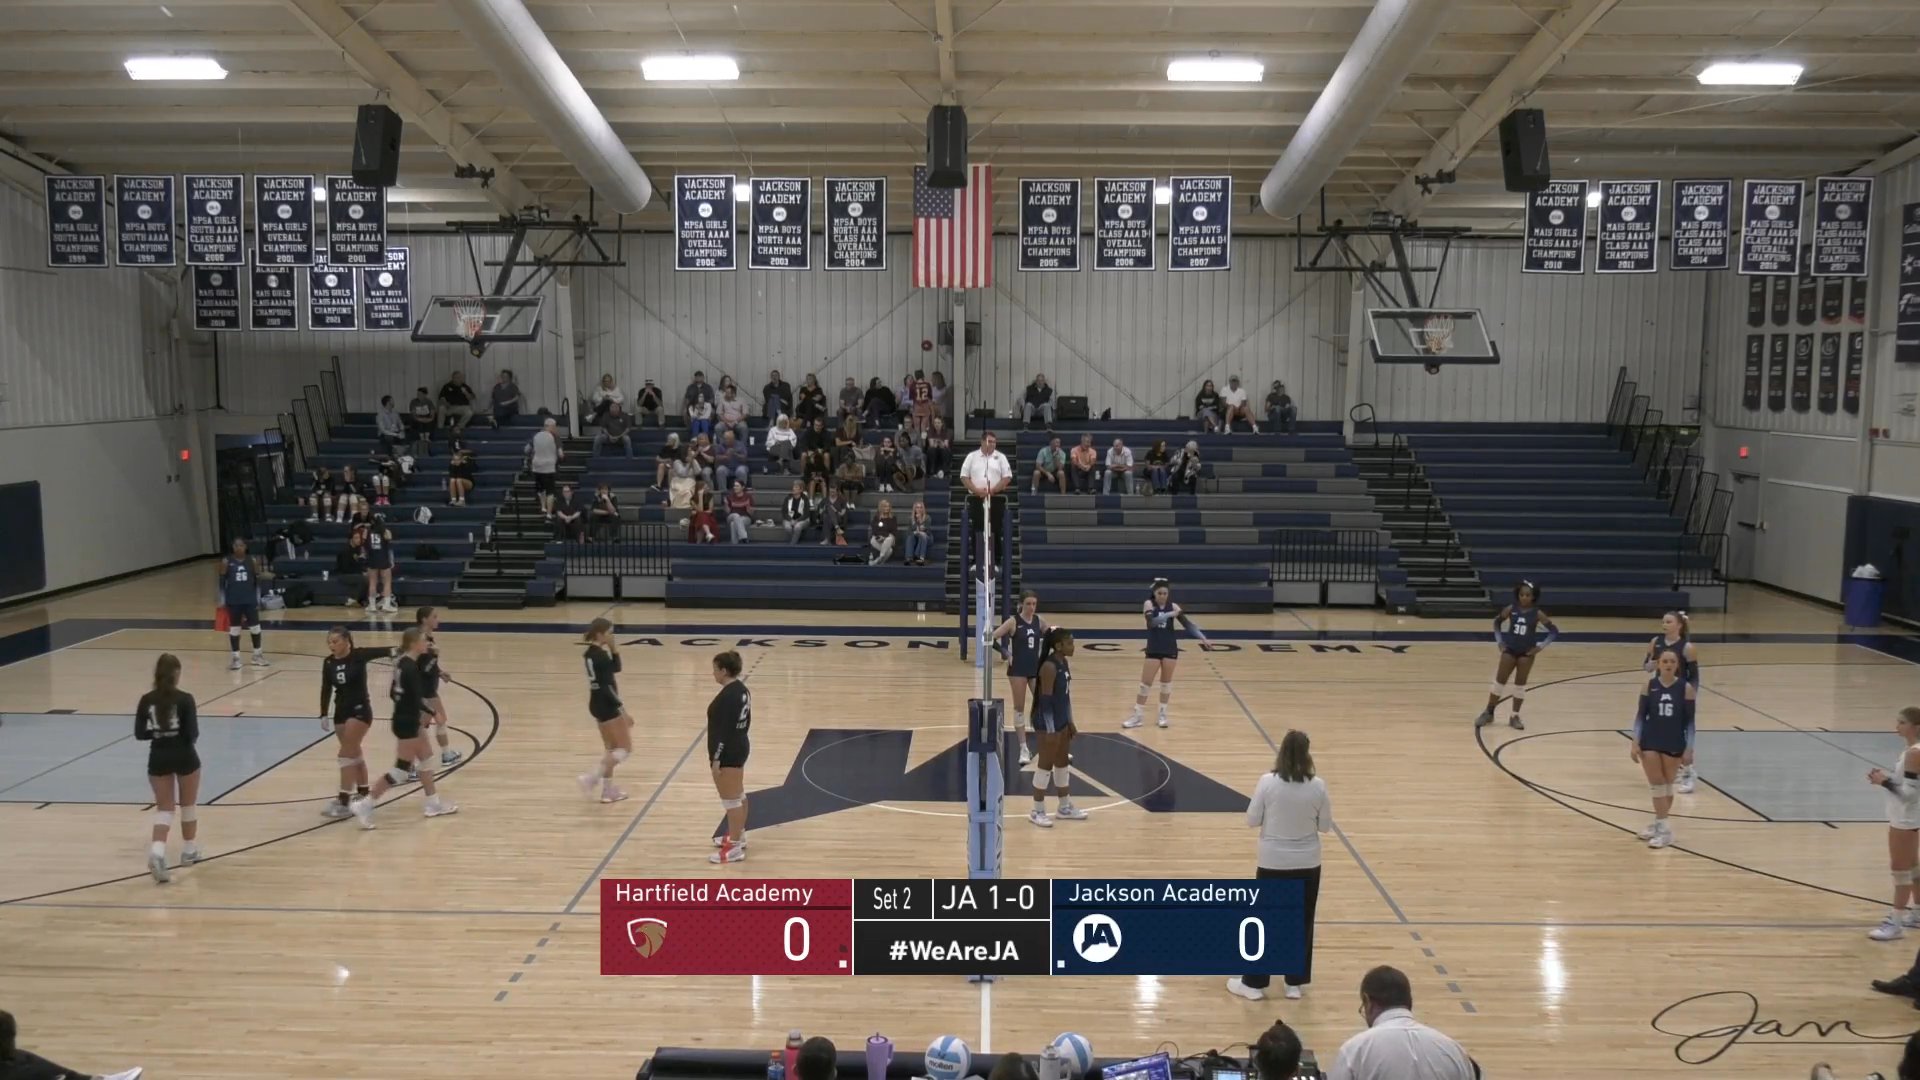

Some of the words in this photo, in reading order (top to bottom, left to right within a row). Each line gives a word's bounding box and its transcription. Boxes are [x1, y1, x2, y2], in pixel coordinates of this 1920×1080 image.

[54, 180, 95, 190] JACKSON
[124, 180, 164, 189] JACKSON
[193, 179, 233, 188] JACKSON
[264, 179, 304, 188] JACKSON
[684, 179, 725, 188] JACKSON
[760, 182, 801, 191] JACKSON
[835, 182, 875, 192] JACKSON
[1029, 183, 1071, 193] JACKSON
[1105, 182, 1146, 192] JACKSON
[1180, 180, 1221, 190] JACKSON
[1824, 182, 1866, 192] JACKSON
[1538, 184, 1579, 194] CKSON
[1609, 184, 1652, 194] JACKSON
[1682, 185, 1724, 195] JACKSON
[1754, 185, 1796, 194] JACKSON
[55, 192, 96, 201] ACADEMY
[124, 192, 165, 201] ACADEMY
[193, 190, 233, 199] ACADEMY
[263, 191, 305, 201] ACADEMY
[335, 192, 377, 201] ACADEMY
[685, 190, 726, 200] ACADEMY
[759, 194, 802, 204] ACADEMY
[835, 192, 876, 202] ACADEMY
[1104, 193, 1146, 203] ACADEMY
[1179, 192, 1222, 202] ACADEMY
[1822, 193, 1866, 202] ACADEMY
[1029, 195, 1072, 205] ACADEMY
[1535, 197, 1579, 206] ACADEMY
[1608, 196, 1652, 206] ACADEMY
[1681, 196, 1724, 206] ACADEMY
[1752, 196, 1796, 205] ACADEMY
[684, 221, 703, 229] MPSA
[834, 218, 854, 226] MPSA
[858, 218, 877, 226] BOYS
[1127, 220, 1146, 228] BOYS
[263, 223, 283, 231] MPSA
[336, 223, 356, 231] MPSA
[759, 225, 778, 234] MPSA
[782, 225, 801, 233] BOYS
[1028, 226, 1049, 235] MPSA
[1052, 226, 1071, 235] BOYS
[1179, 226, 1199, 234] MPSA
[1201, 226, 1221, 234] BOYS
[1607, 223, 1625, 231] MAIS
[1099, 230, 1122, 238] CLASS
[1125, 230, 1139, 238] AAA
[1534, 228, 1553, 236] MAIS
[1601, 232, 1625, 240] CLASS
[1627, 232, 1644, 240] AAA
[1700, 230, 1715, 238] AAA
[757, 236, 783, 244] NORTH
[786, 236, 801, 244] AAA
[1023, 237, 1047, 245] CLASS
[1049, 237, 1065, 245] AAA
[1106, 239, 1142, 247] OVERALL
[1173, 237, 1197, 245] CLASS
[56, 244, 98, 252] CHAMPIONS
[124, 244, 167, 252] CHAMPIONS
[194, 244, 236, 252] CHAMPIONS
[264, 244, 307, 252] CHAMPIONS
[336, 244, 378, 252] CHAMPIONS
[1605, 242, 1630, 250] CLASS
[684, 249, 727, 257] CHAMPIONS
[758, 247, 801, 255] CHAMPIONS
[834, 251, 877, 259] CHAMPIONS
[1028, 248, 1071, 256] CHAMPIONS
[1103, 249, 1146, 257] CHAMPIONS
[1178, 248, 1221, 256] CHAMPIONS
[1532, 249, 1576, 258] CHAMPIONS
[1605, 251, 1648, 259] CHAMPIONS
[1678, 247, 1723, 255] CHAMPIONS
[277, 255, 294, 263] 2001
[845, 259, 865, 267] 2004
[1040, 259, 1058, 267] 2005
[1190, 259, 1209, 267] 2007
[1544, 261, 1562, 269] 2010
[574, 637, 951, 649] ACKSON
[1658, 702, 1674, 716] 16
